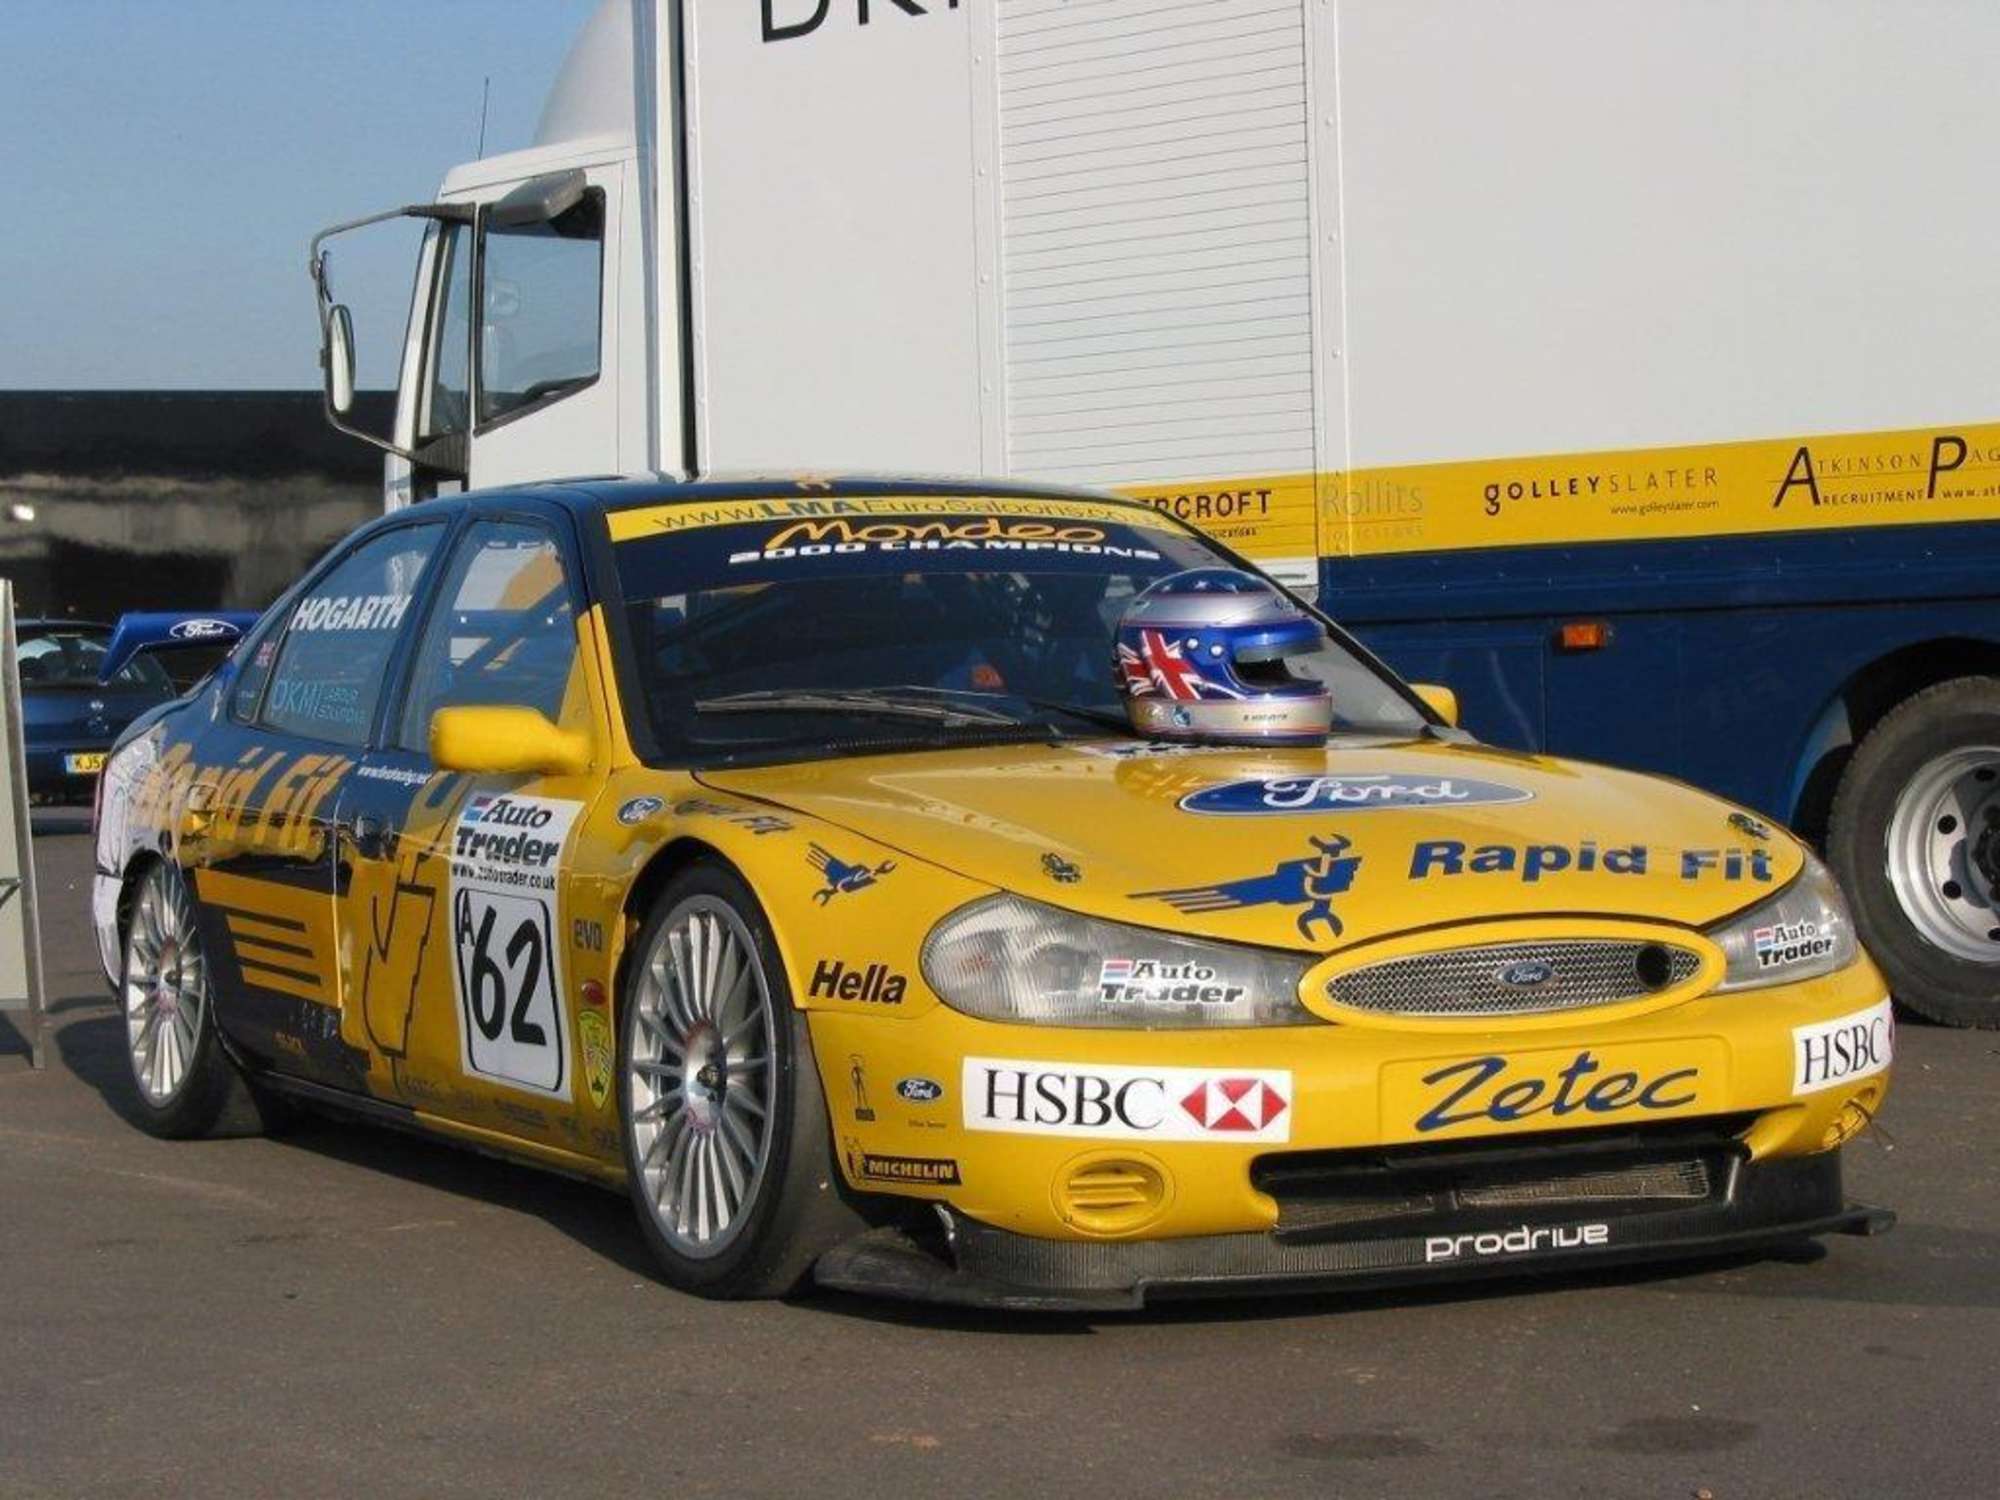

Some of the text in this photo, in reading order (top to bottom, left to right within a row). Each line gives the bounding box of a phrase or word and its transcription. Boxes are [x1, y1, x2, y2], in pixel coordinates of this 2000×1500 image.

[1773, 446, 1921, 508] ATKINSON
[1822, 488, 1924, 506] RECRUITMENT
[728, 539, 1160, 564] 2000 CHAMPIONS
[765, 518, 1105, 550] Mondeo
[289, 594, 413, 631] HOGARTH
[1262, 775, 1470, 808] Ford
[480, 799, 553, 829] Auto
[456, 827, 561, 867] Trader
[1408, 840, 1774, 884] Rapid Fit
[452, 862, 556, 891] www.autotrader.co.uk
[460, 889, 475, 947] A
[1773, 922, 1816, 944] Auto
[1132, 961, 1214, 980] Auto
[1757, 939, 1833, 967] Trader
[471, 904, 547, 1047] 62
[808, 959, 907, 1005] Hella
[1100, 982, 1245, 1003] Trader
[1803, 1016, 1885, 1085] HSBC
[984, 1067, 1166, 1130] HSBC
[1415, 1050, 1698, 1132] Zetec
[868, 1158, 955, 1180] MICHELIN
[1425, 1222, 1609, 1263] prodrive
